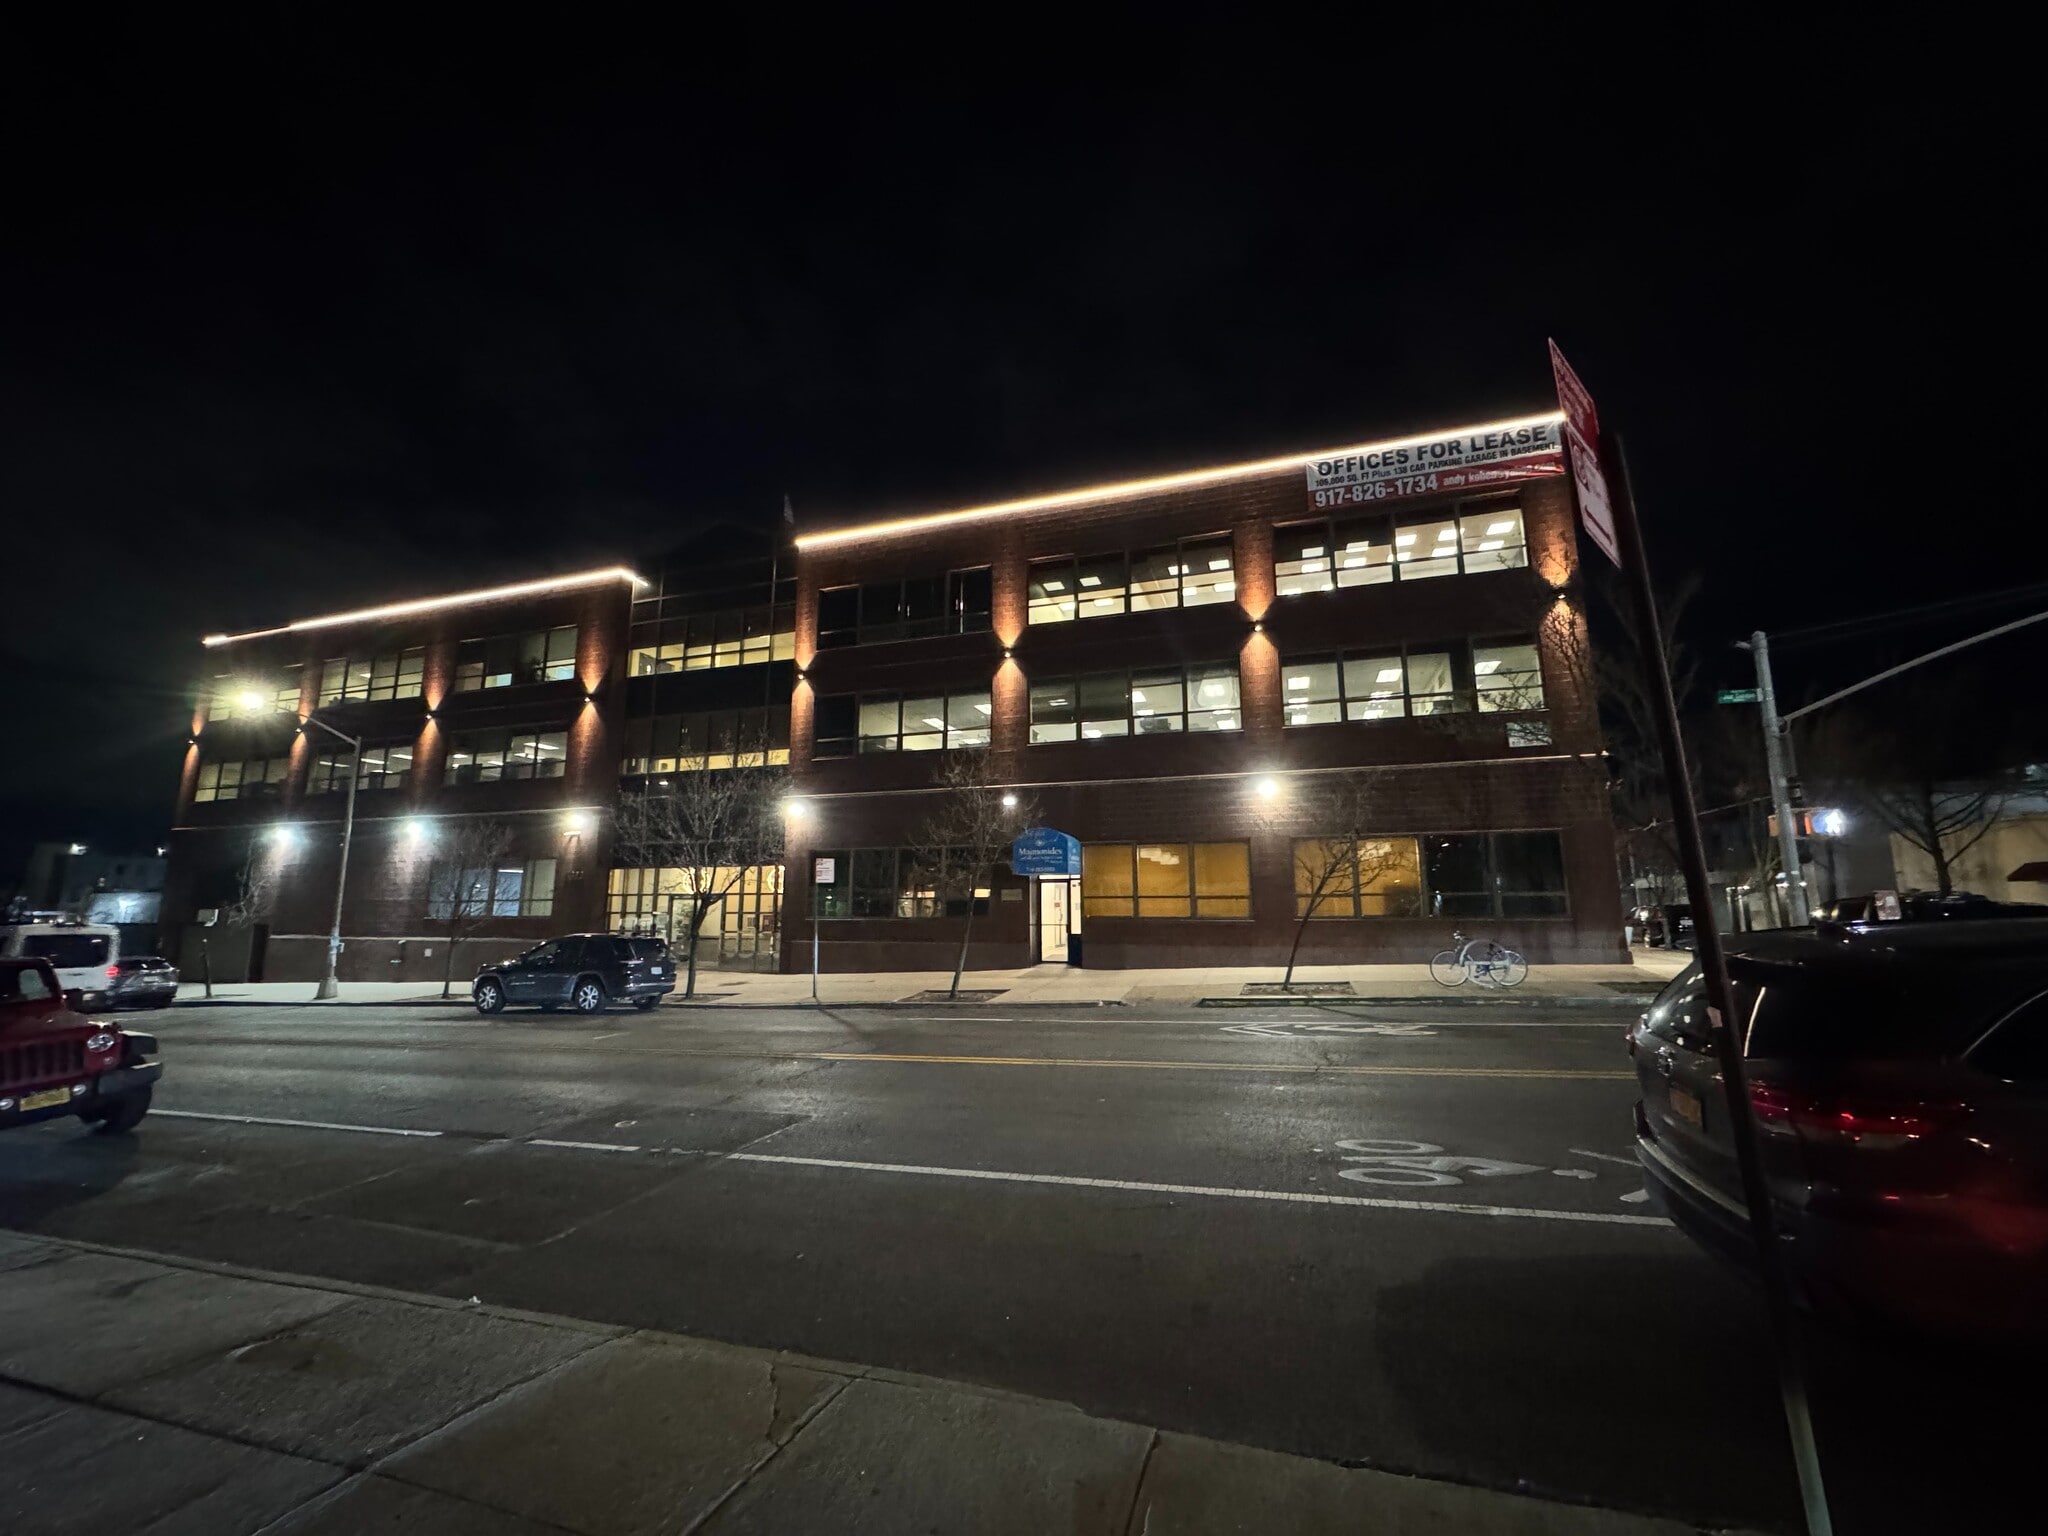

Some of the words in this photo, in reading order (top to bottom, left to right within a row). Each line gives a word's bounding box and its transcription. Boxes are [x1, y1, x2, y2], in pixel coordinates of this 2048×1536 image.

[1318, 449, 1409, 476] OFFICES
[1417, 439, 1463, 461] FOR
[1470, 426, 1547, 452] LEASE
[1361, 471, 1370, 480] FT
[1372, 470, 1391, 478] Plus
[1410, 463, 1426, 472] CAR
[1428, 457, 1463, 470] PARKING
[1465, 451, 1498, 463] GARAGE
[1500, 450, 1508, 458] IN
[1511, 441, 1556, 456] BASEMENT
[1315, 473, 1438, 508] 917-826-1734
